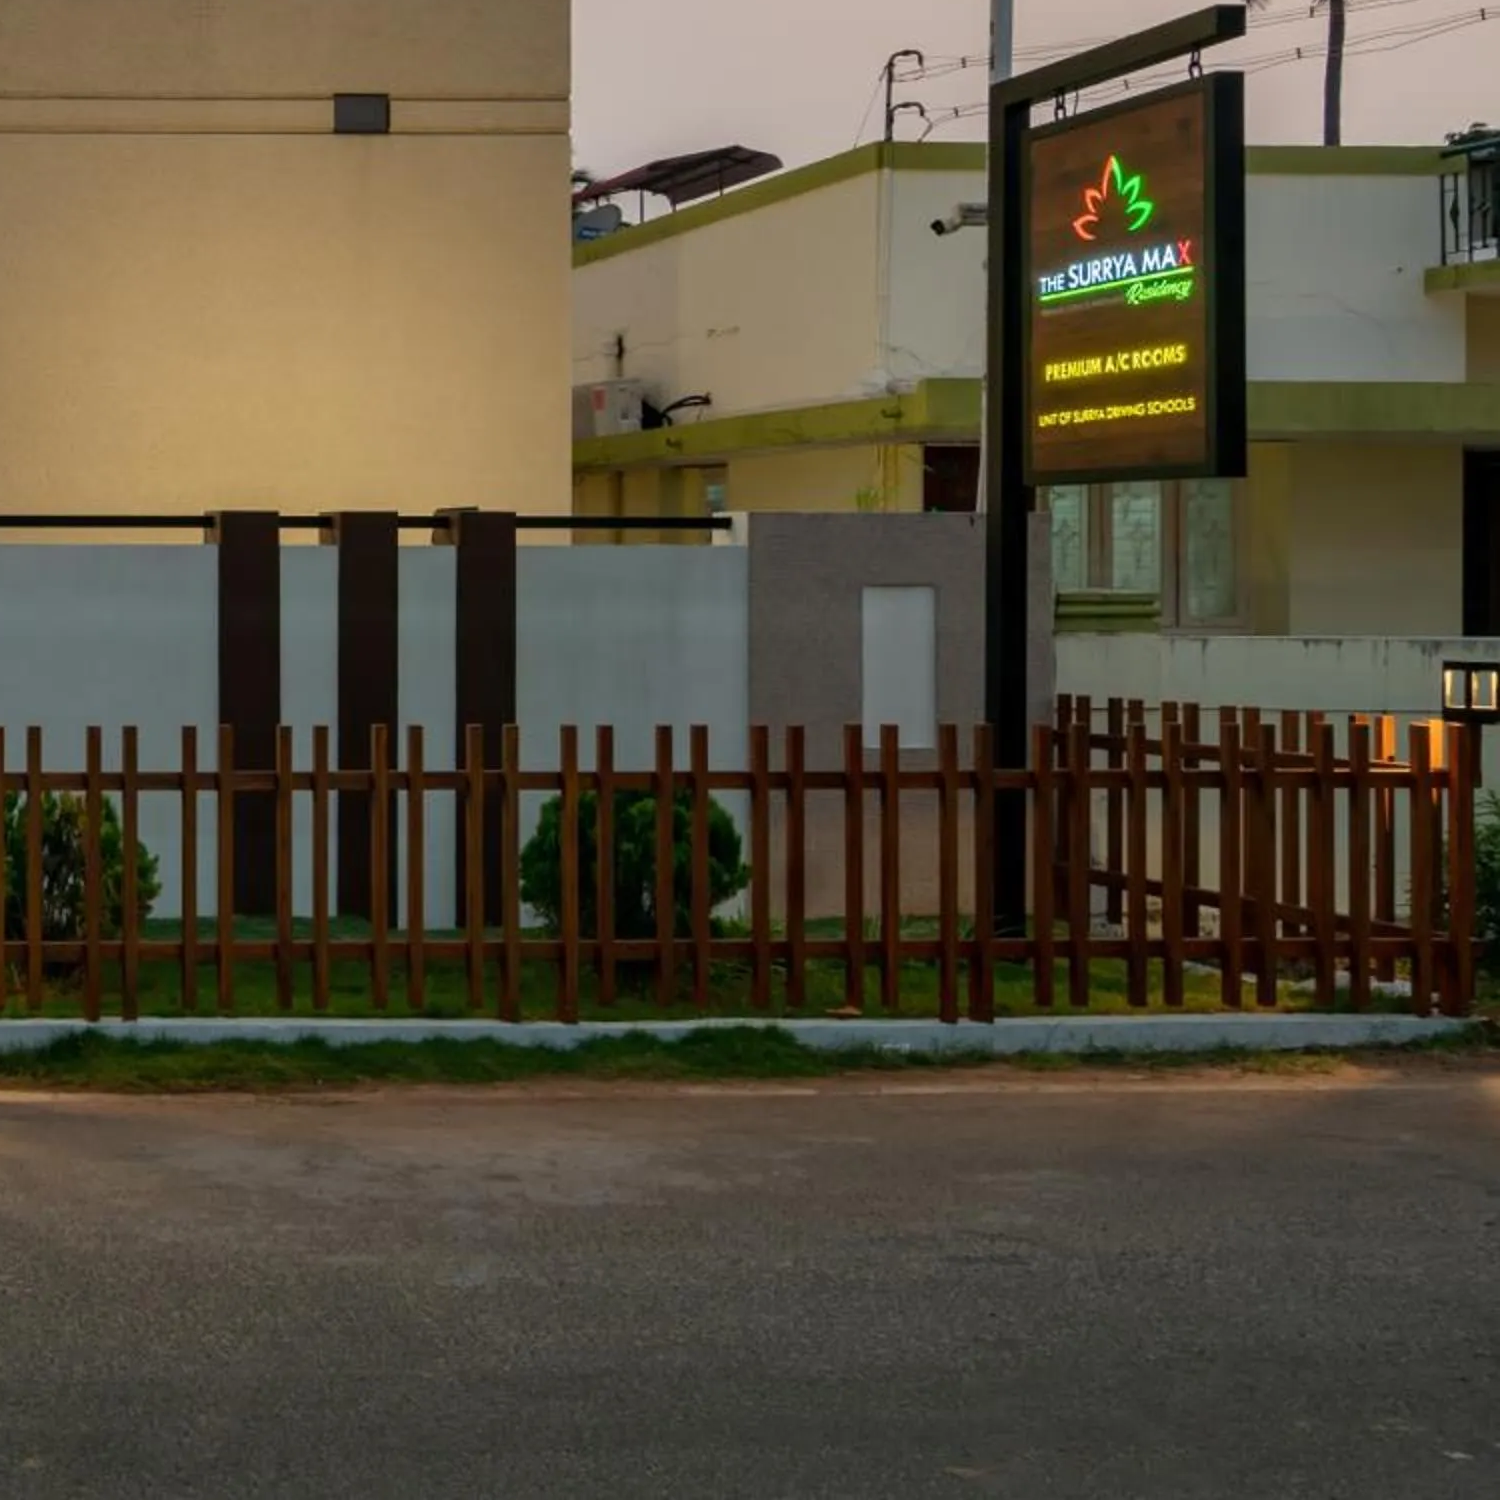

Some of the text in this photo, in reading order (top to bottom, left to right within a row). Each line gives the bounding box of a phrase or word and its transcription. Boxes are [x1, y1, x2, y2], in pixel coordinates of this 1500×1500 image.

[1038, 239, 1192, 293] THE SURRYA MAX
[1126, 279, 1192, 305] Residency
[1044, 344, 1187, 382] PREMIUM A/C ROOMS
[1059, 411, 1071, 425] OF
[1105, 402, 1145, 419] DRIVING
[1147, 397, 1196, 416] SCHOOLS
